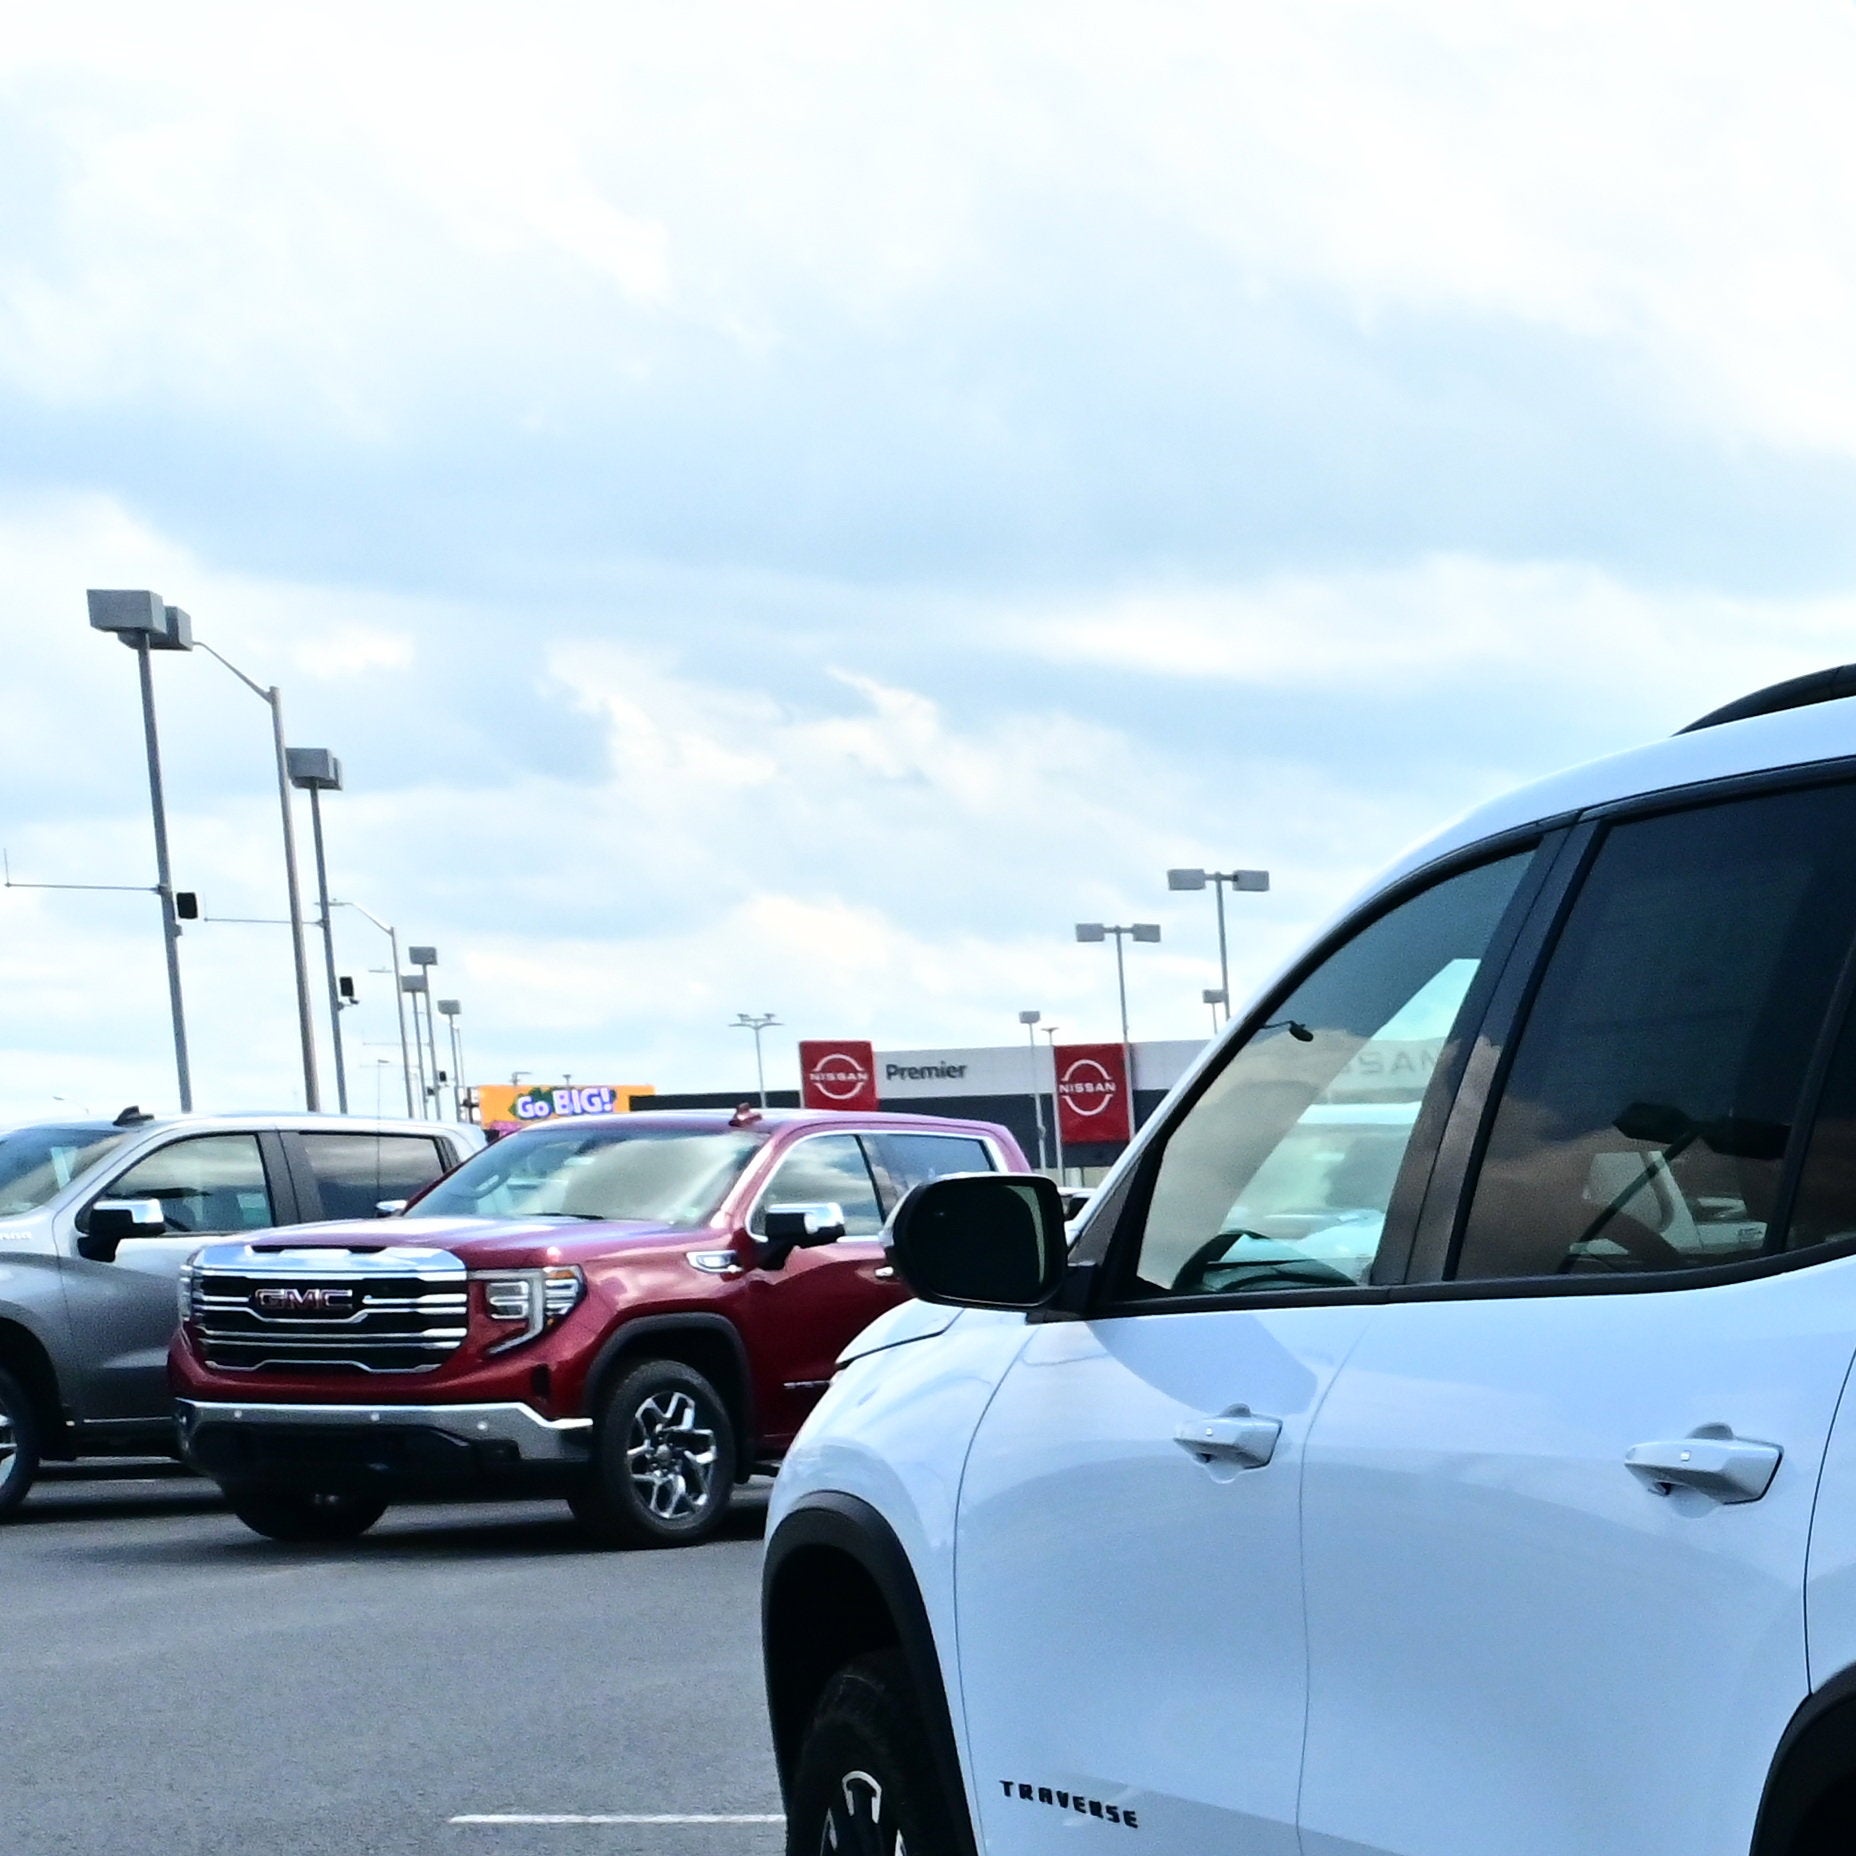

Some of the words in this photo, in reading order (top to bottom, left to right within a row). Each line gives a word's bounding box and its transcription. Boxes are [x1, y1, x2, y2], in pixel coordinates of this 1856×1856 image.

[809, 1071, 869, 1083] NISSAN
[886, 1060, 967, 1081] Premier
[1058, 1081, 1117, 1094] NISSAN
[516, 1095, 550, 1119] Go
[552, 1087, 613, 1115] BIG!
[255, 1288, 353, 1310] GMC
[999, 1780, 1138, 1829] TRAVERSE
